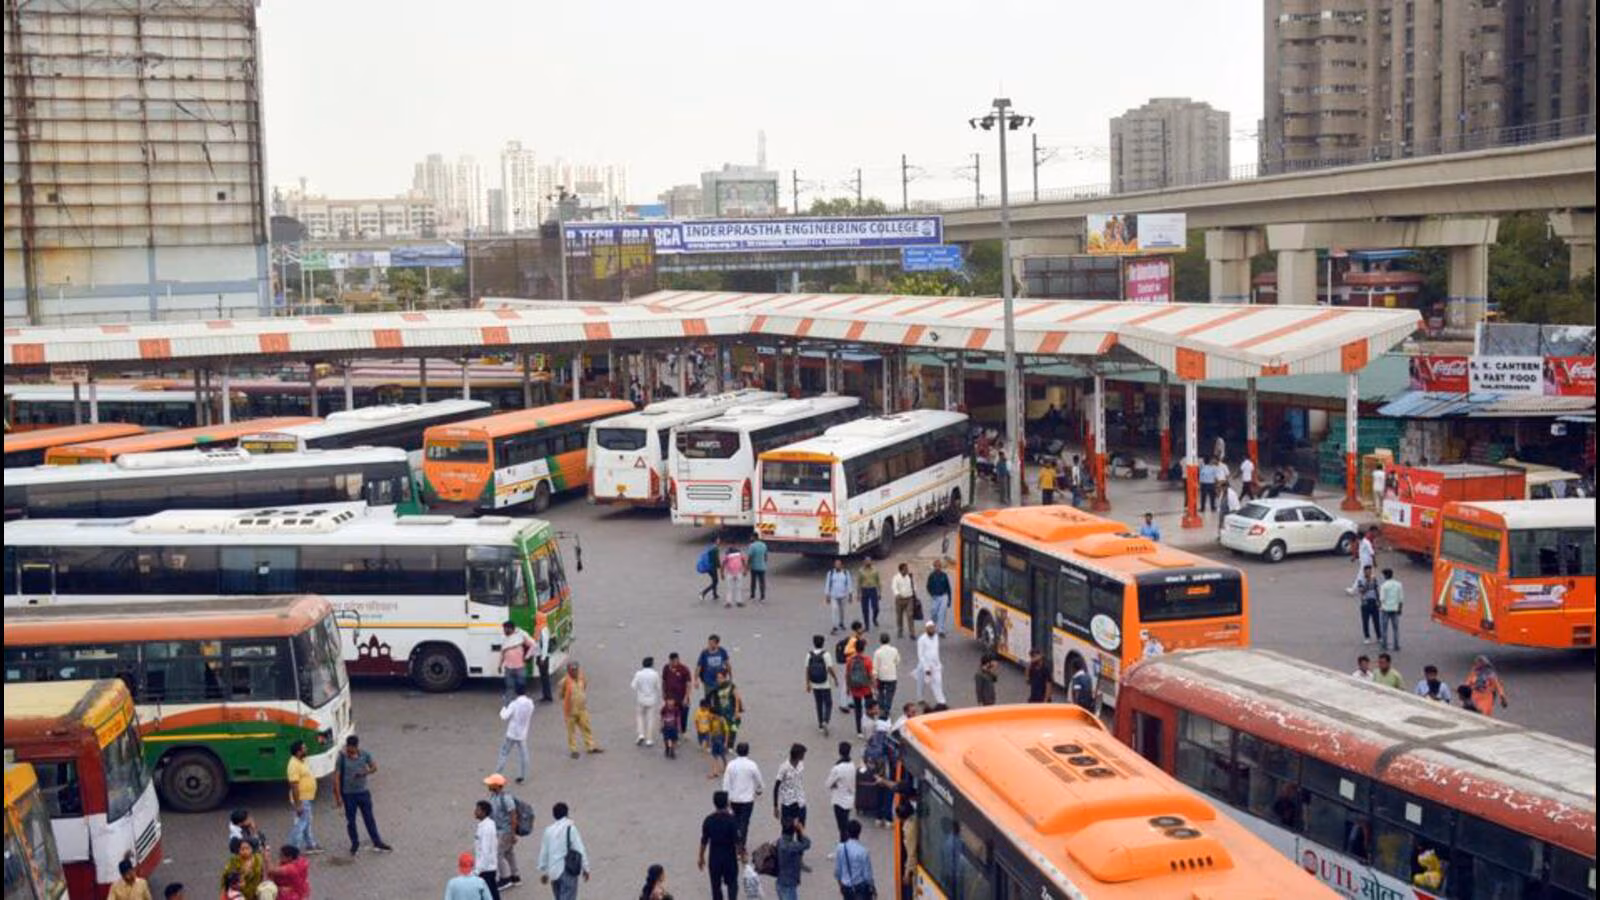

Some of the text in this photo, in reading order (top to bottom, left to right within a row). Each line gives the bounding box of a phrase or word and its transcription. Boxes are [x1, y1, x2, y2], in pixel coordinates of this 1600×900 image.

[654, 227, 681, 246] BCA
[686, 220, 919, 238] INDERPRASTHA ENGINEERING COLLEGE
[1495, 362, 1540, 371] CANTEEN
[1483, 373, 1505, 382] FAST
[1510, 374, 1537, 382] FOOD
[1321, 858, 1360, 894] UTL
